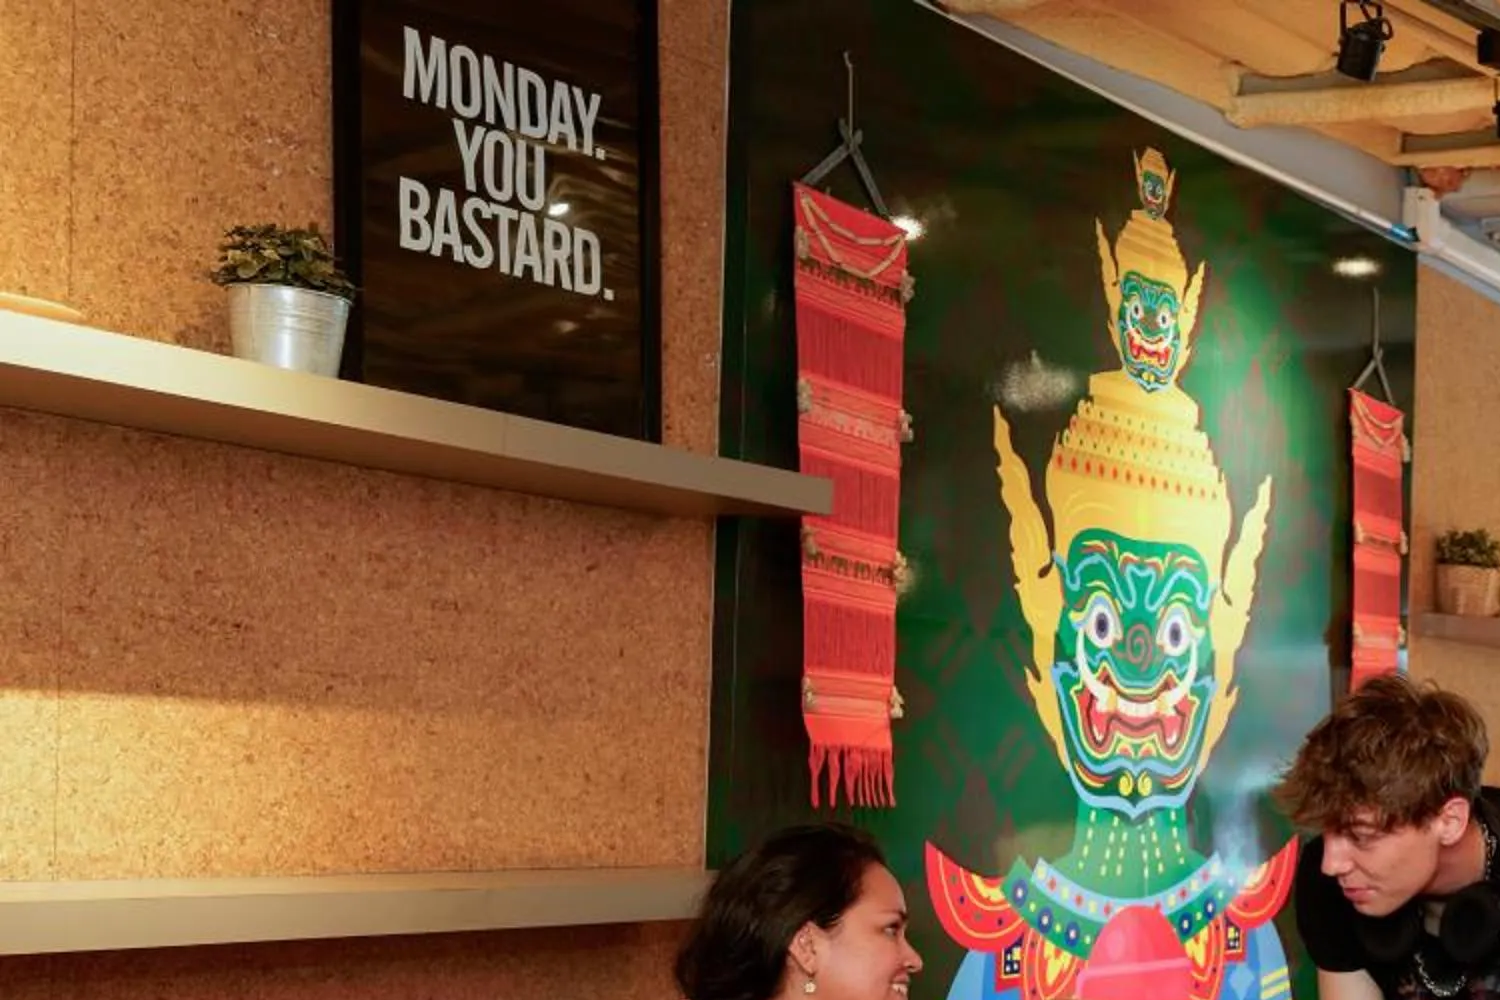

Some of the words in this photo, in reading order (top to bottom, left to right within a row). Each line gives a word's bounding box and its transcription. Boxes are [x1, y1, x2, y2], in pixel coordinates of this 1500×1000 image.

[403, 25, 606, 160] MONDAY.
[452, 117, 546, 211] YOU
[399, 176, 615, 300] BASTARD.
